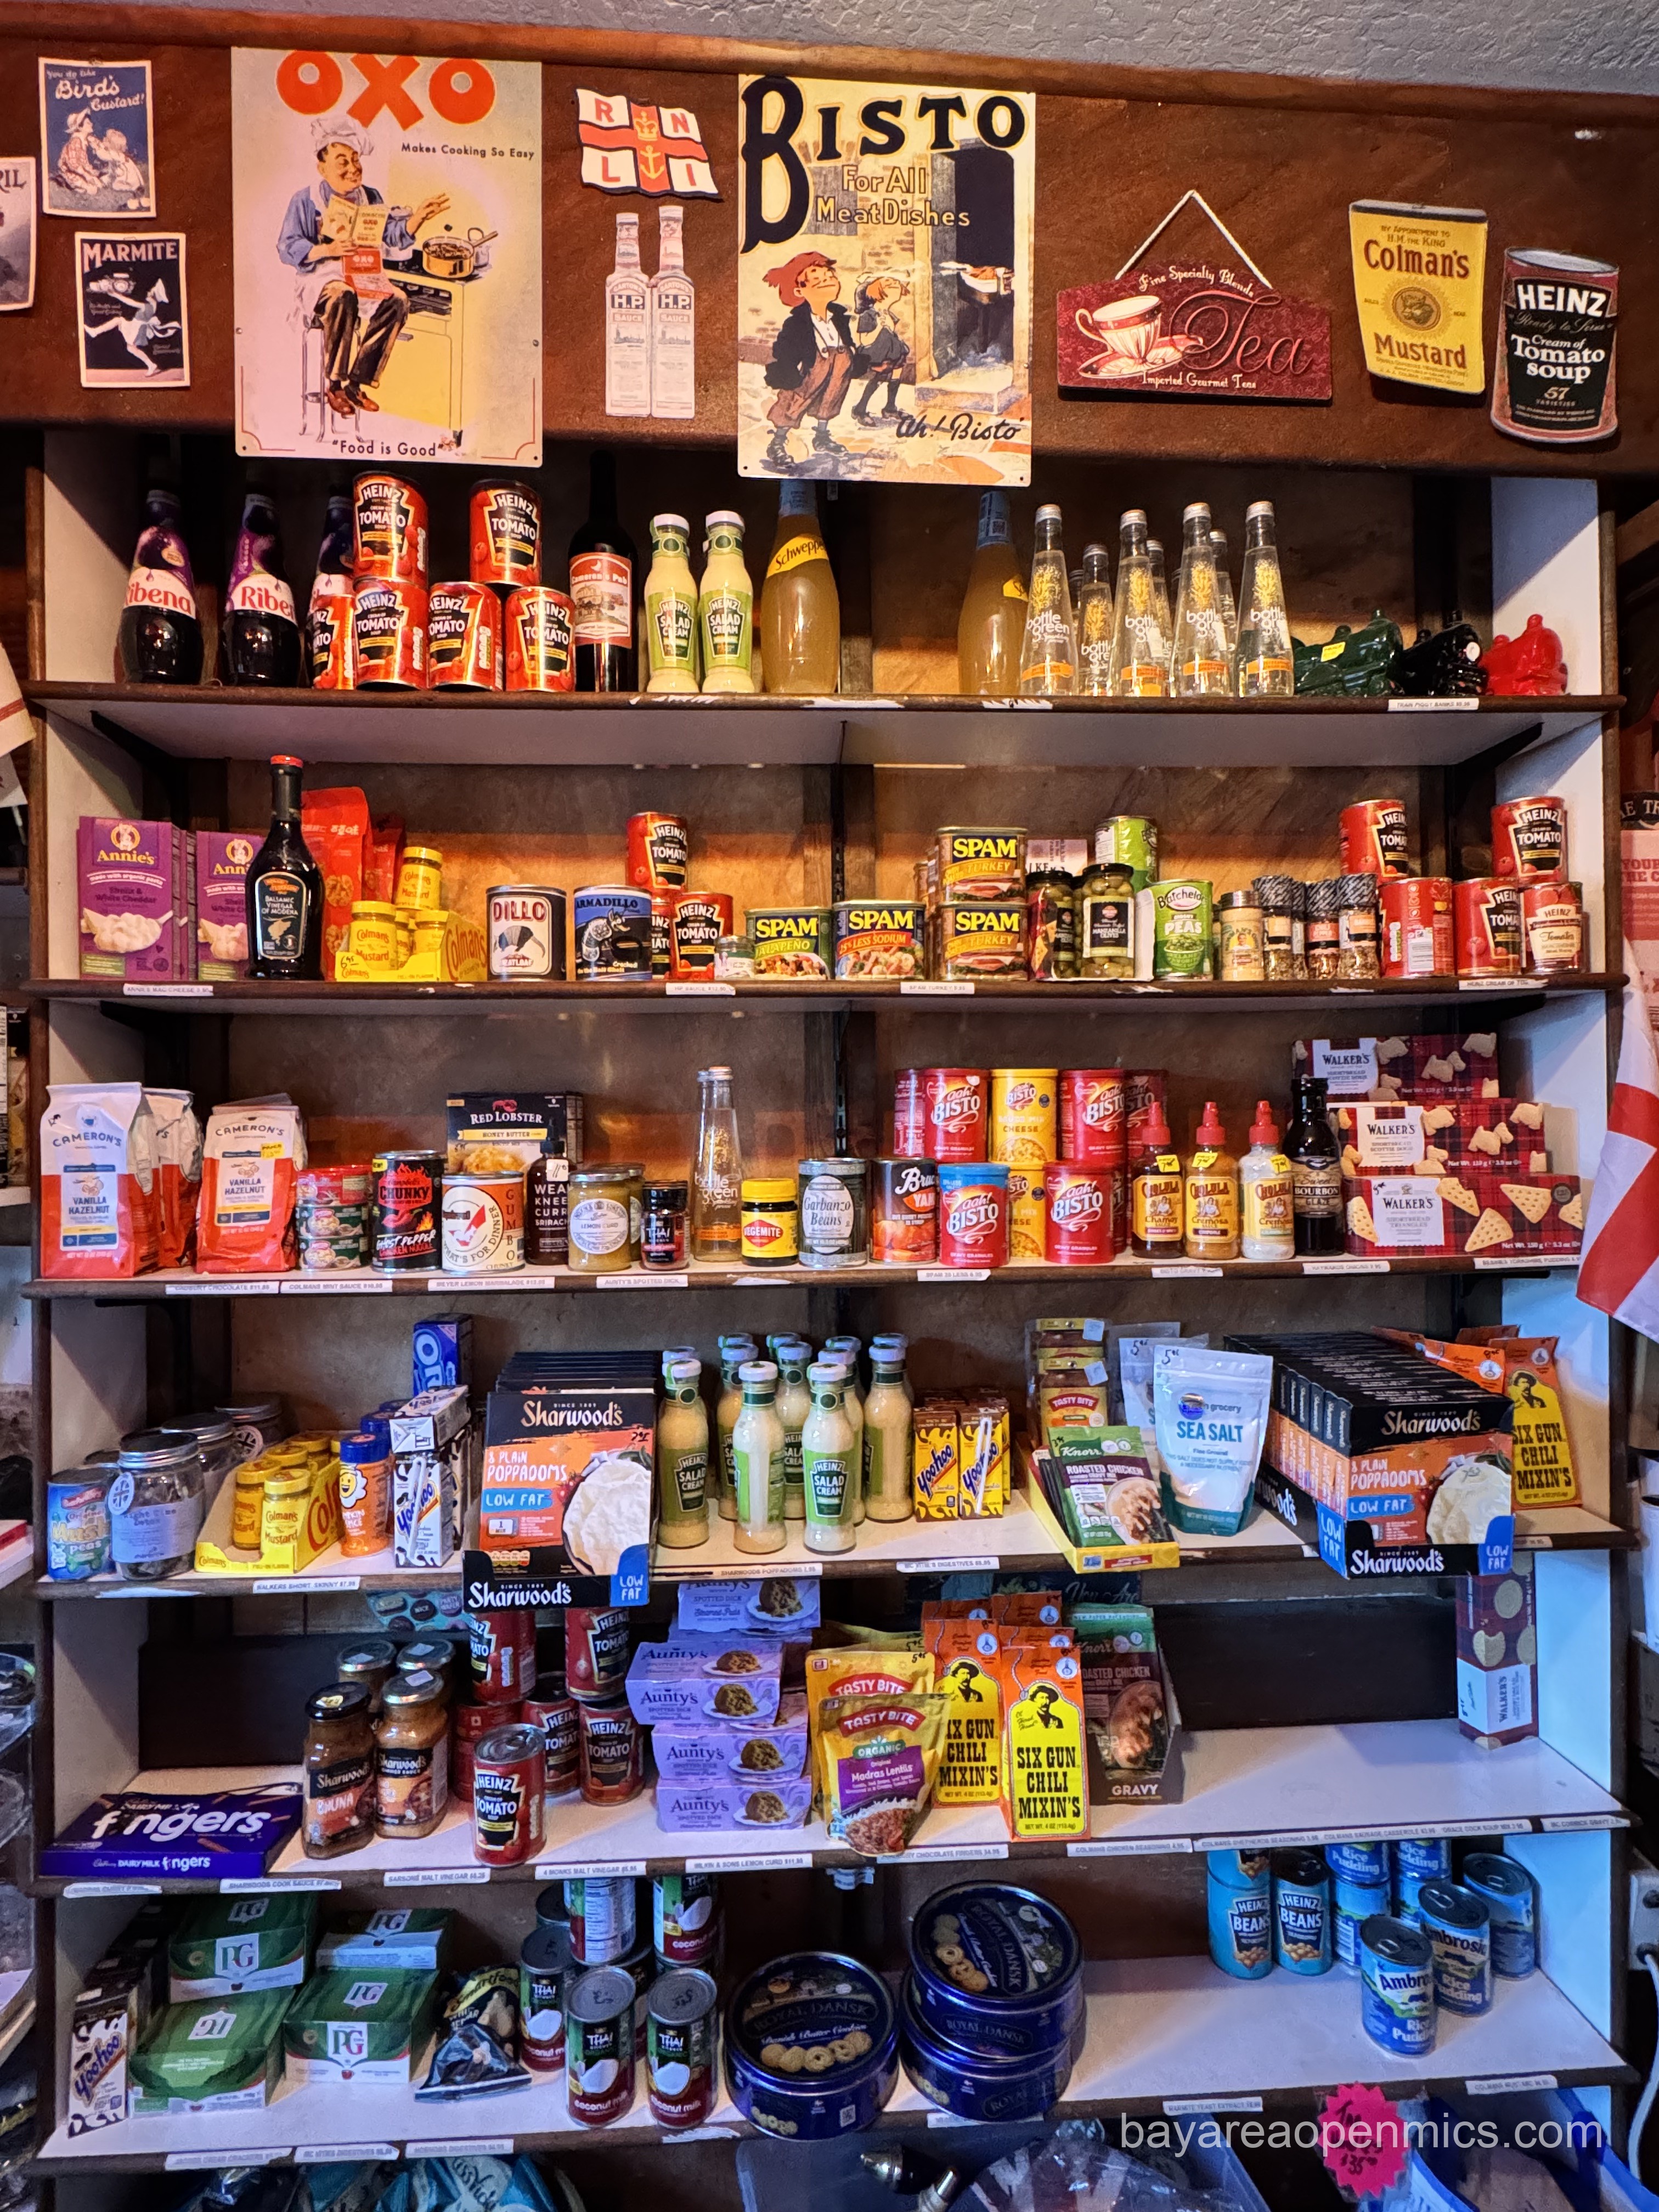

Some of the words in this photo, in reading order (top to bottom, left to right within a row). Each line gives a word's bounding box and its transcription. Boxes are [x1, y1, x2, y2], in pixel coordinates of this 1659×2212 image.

[55, 76, 120, 100] Bird's
[276, 50, 495, 131] OXO
[91, 93, 145, 111] Custard!
[595, 98, 614, 123] R
[670, 112, 690, 134] N
[401, 142, 436, 154] Makes
[441, 144, 486, 158] Cooking
[491, 146, 505, 157] So
[510, 148, 534, 160] Easy
[740, 76, 1025, 255] BISTO
[842, 165, 884, 192] For
[886, 166, 926, 194] All
[816, 196, 882, 225] Meat
[882, 198, 971, 227] Dishes
[83, 242, 177, 274] MARMITE
[1363, 239, 1470, 279] Colman's
[1138, 273, 1166, 291] Fine
[1169, 266, 1215, 285] Specialty
[1219, 269, 1254, 298] Blends
[1516, 284, 1607, 318] HEINZ
[614, 313, 642, 323] SAUCE
[661, 314, 689, 323] SAUCE
[1169, 290, 1312, 375] Tea
[1373, 331, 1467, 369] Mustard
[1511, 334, 1606, 364] Tomato
[1531, 335, 1571, 348] Cream
[1572, 338, 1585, 352] of
[1142, 373, 1183, 389] Imported
[1186, 373, 1229, 388] Gourmet
[1232, 374, 1256, 389] Teas
[1526, 362, 1591, 384] soup
[1544, 386, 1570, 400] 57
[895, 415, 942, 439] Ah!
[950, 413, 1022, 441] Bisto
[363, 483, 402, 503] HEINZ
[496, 494, 533, 516] HEINZ
[358, 511, 406, 528] TOMATO
[492, 517, 535, 541] TOMATO
[360, 591, 396, 608] HEINZ
[357, 617, 398, 632] TOMATO
[660, 616, 690, 630] SALAD
[710, 613, 741, 627] SALAD
[1026, 610, 1061, 630] bottle
[524, 625, 569, 645] TOMATO
[1032, 623, 1070, 642] green
[1522, 809, 1560, 822] HEINZ
[656, 826, 686, 838] HEINZ
[1517, 832, 1561, 844] TOMATO
[97, 850, 155, 865] Annie's
[652, 845, 686, 860] TOMATO
[952, 839, 1017, 859] SPAM
[967, 861, 1011, 873] TURKEY
[681, 907, 714, 920] HEINZ
[849, 911, 915, 930] SPAM
[1544, 907, 1571, 918] HEINZ
[755, 918, 819, 938] SPAM
[955, 913, 1020, 932] SPAM
[1164, 921, 1203, 935] PEAS
[358, 929, 390, 943] Colman's
[677, 928, 718, 941] TOMATO
[853, 938, 871, 950] LESS
[872, 933, 906, 946] SODIUM
[969, 935, 1014, 947] TURKEY
[1322, 1054, 1370, 1065] WALKER'S
[470, 1114, 494, 1125] RED
[495, 1111, 544, 1124] LOBSTER
[934, 1095, 981, 1124] BISTO
[215, 1125, 285, 1137] CAMERON'S
[1367, 1124, 1415, 1135] WALKER'S
[53, 1132, 122, 1148] CAMERON'S
[224, 1186, 266, 1195] HAZELNUT
[229, 1178, 262, 1187] VANILLA
[379, 1186, 431, 1200] CHUNKY
[1295, 1187, 1339, 1196] BOURBON
[72, 1197, 107, 1205] VANILLA
[803, 1197, 851, 1212] Garbanzo
[1053, 1192, 1104, 1221] BISTO
[1383, 1198, 1433, 1210] WALKER'S
[69, 1205, 110, 1215] HAZELNUT
[810, 1211, 842, 1226] Beans
[949, 1203, 1000, 1233] BISTO
[1192, 1217, 1229, 1225] Cremosa
[471, 1244, 491, 1262] FOR
[490, 1206, 503, 1249] DINNER
[744, 1227, 782, 1239] VEGEMITE
[1052, 1397, 1075, 1408] TASTY
[1076, 1397, 1096, 1407] BITE
[521, 1400, 623, 1427] Sharwood's
[1381, 1410, 1481, 1436] Sharwood's
[1177, 1421, 1206, 1440] SEA
[1208, 1424, 1244, 1443] SALT
[1534, 1423, 1562, 1443] GUN
[499, 1451, 528, 1464] PLAIN
[1060, 1446, 1102, 1457] Knorr
[1521, 1447, 1558, 1467] CHILI
[487, 1464, 567, 1483] POPPADOMS
[816, 1461, 843, 1472] HEINZ
[1066, 1464, 1106, 1475] ROASTED
[1107, 1465, 1144, 1476] CHICKEN
[814, 1475, 844, 1487] SALAD
[1517, 1468, 1572, 1489] MIXIN'S
[816, 1486, 842, 1496] CREAM
[486, 1493, 514, 1507] LOW
[520, 1493, 545, 1506] FAT
[640, 1688, 698, 1705] Aunty's
[844, 1713, 880, 1730] TASTY
[881, 1711, 916, 1725] BITE
[857, 1743, 901, 1757] ORGANIC
[1017, 1747, 1042, 1769] SIX
[1046, 1747, 1076, 1768] GUN
[851, 1768, 885, 1782] Madras
[886, 1764, 914, 1778] Lentils
[478, 1774, 514, 1792] HEINZ
[1026, 1771, 1069, 1793] CHILI
[1111, 1784, 1158, 1796] GRAVY
[670, 1796, 730, 1813] Aunty's
[1018, 1797, 1081, 1819] MIXIN'S
[1280, 1907, 1322, 1928] BEANS
[658, 2033, 684, 2048] THAI
